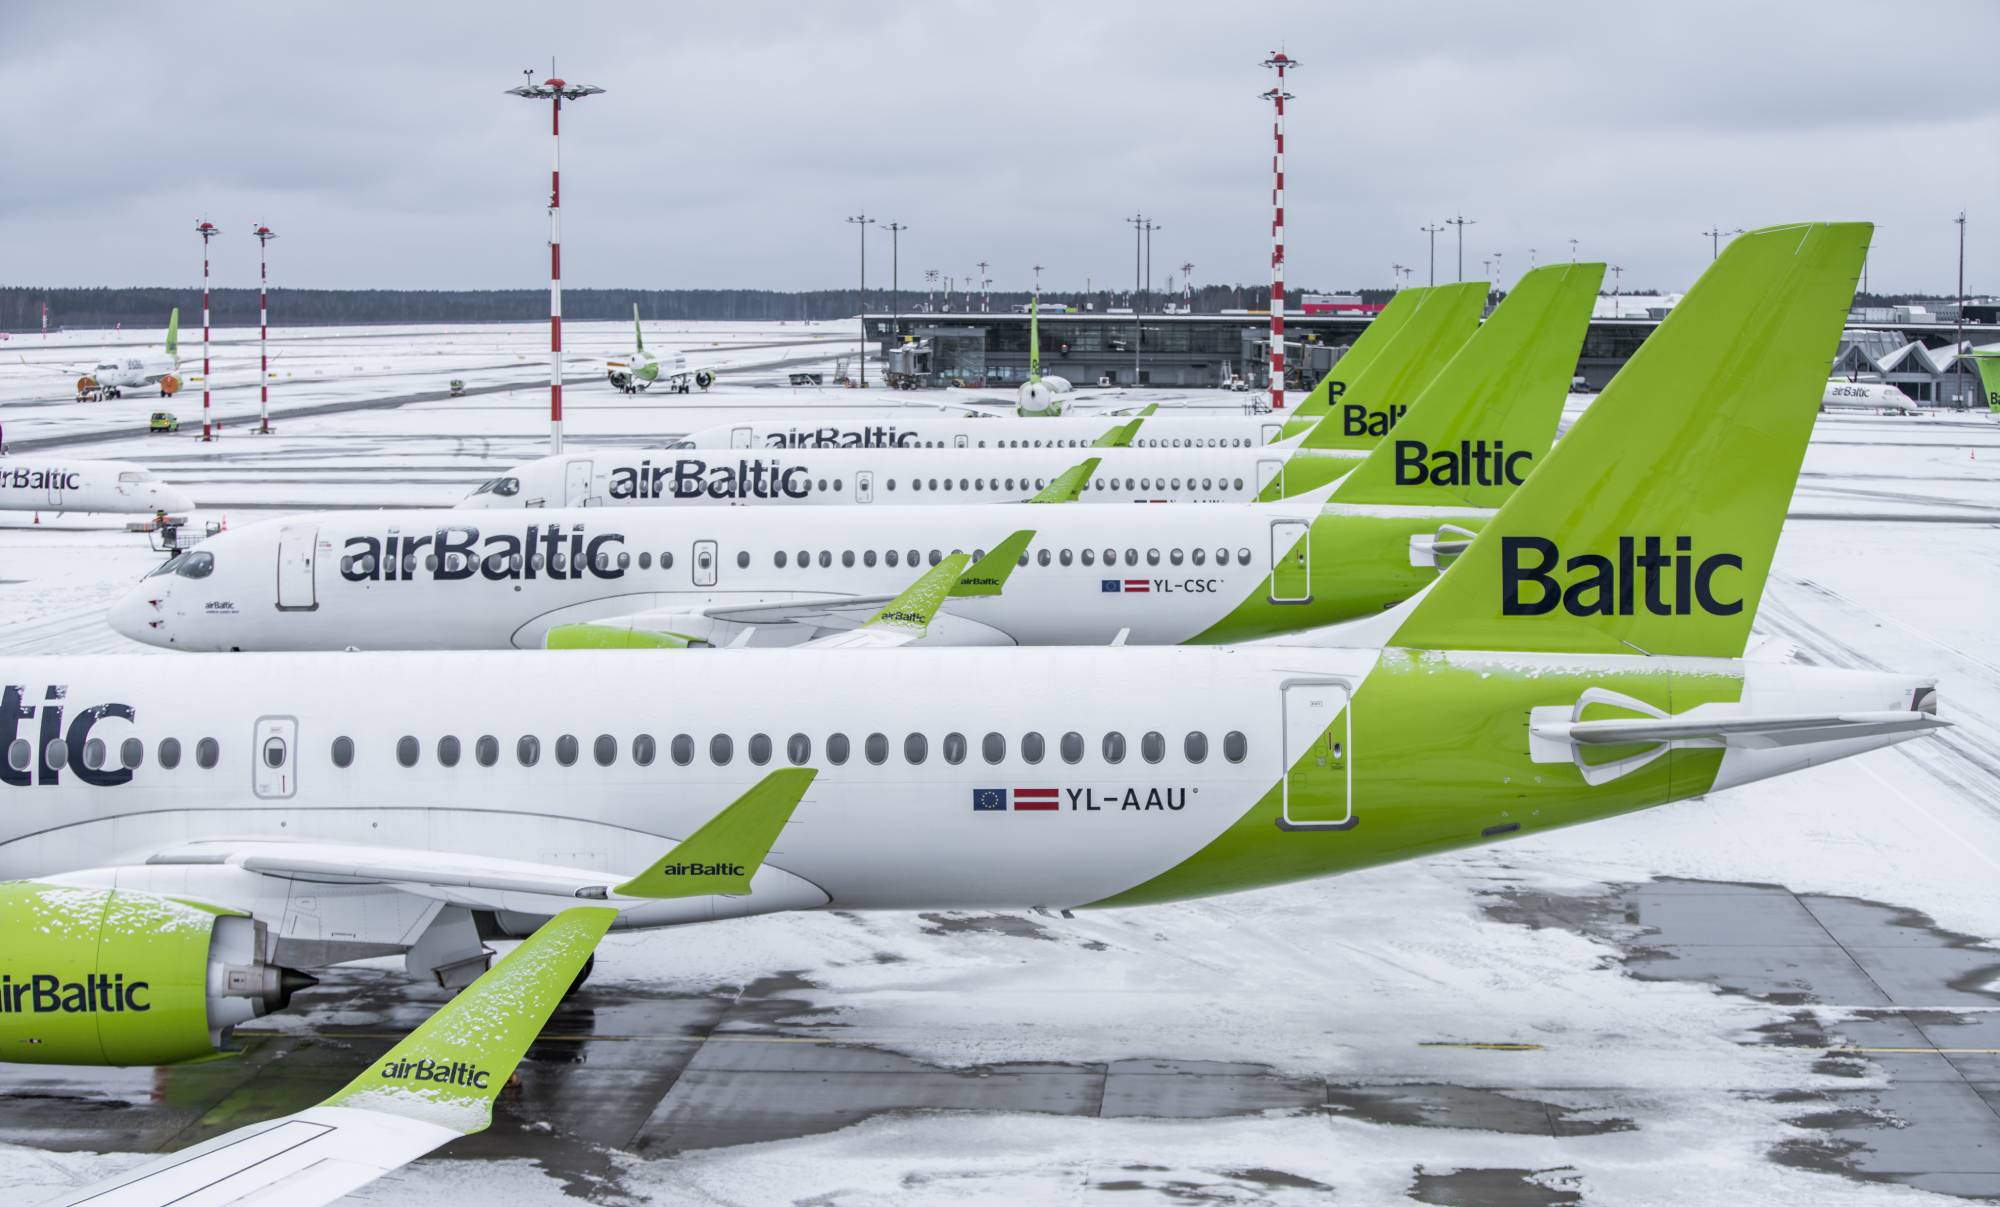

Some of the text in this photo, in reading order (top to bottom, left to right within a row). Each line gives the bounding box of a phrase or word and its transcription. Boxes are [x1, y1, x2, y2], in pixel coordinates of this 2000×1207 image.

[1832, 386, 1871, 398] airBaltic
[1990, 392, 2000, 404] B
[1395, 440, 1533, 486] Baltic
[609, 459, 808, 499] airBaltic
[340, 524, 625, 581] airBaltic
[960, 577, 999, 586] airBaltic
[1501, 536, 1743, 616] Baltic
[1153, 579, 1217, 592] YL-CSC
[205, 601, 234, 609] airBaltic
[881, 611, 926, 623] airBaltic
[1066, 787, 1186, 811] YL-AAU
[664, 863, 745, 876] airBaltic
[0, 973, 150, 1013] irBaltic
[381, 1057, 490, 1089] airBaltic
